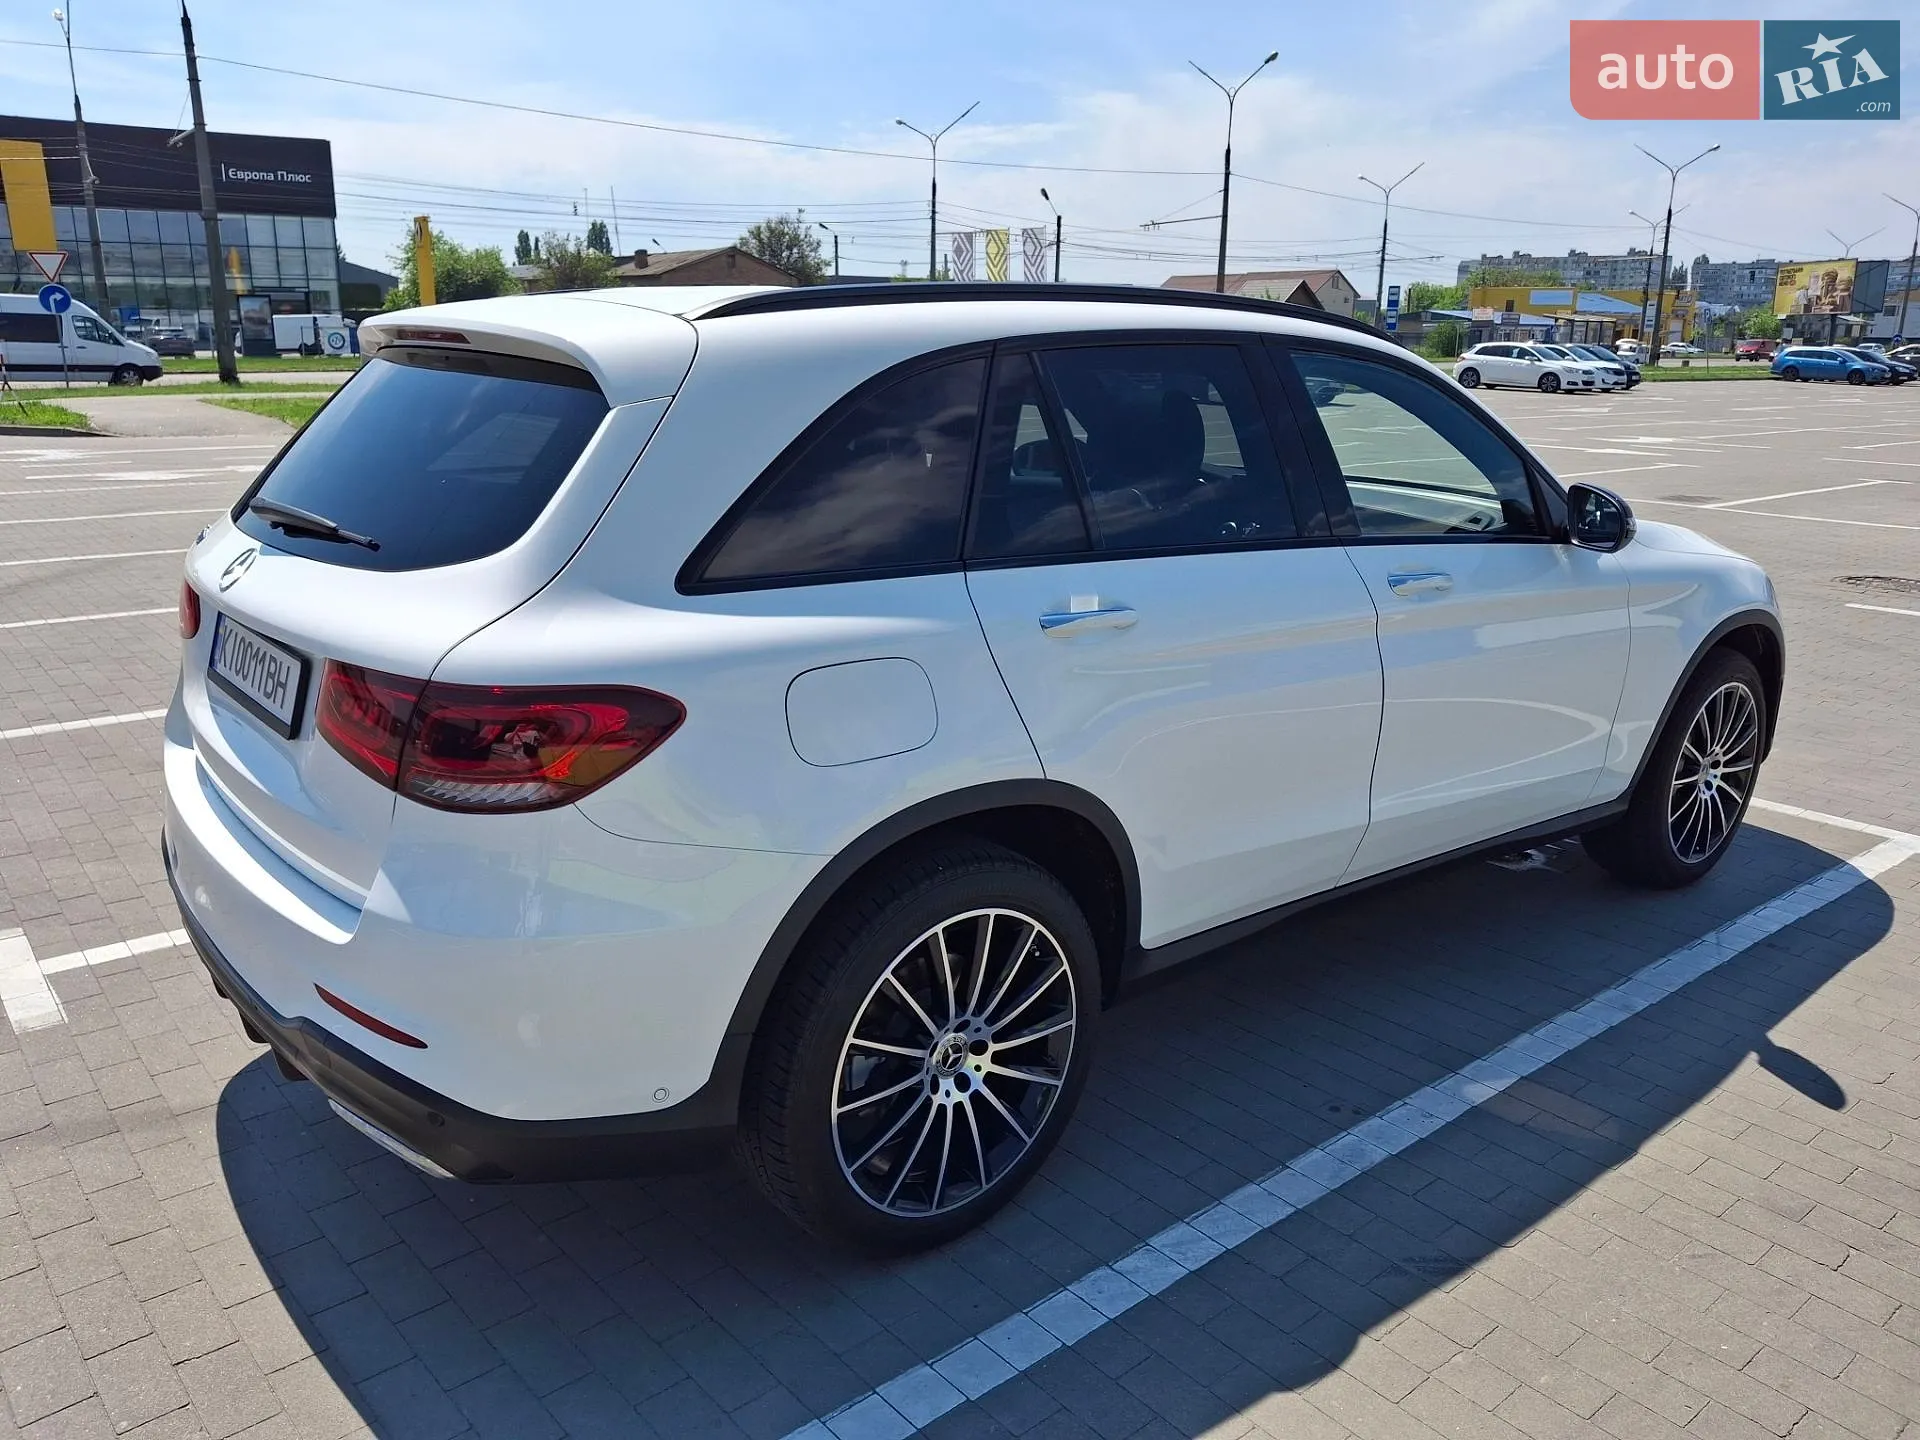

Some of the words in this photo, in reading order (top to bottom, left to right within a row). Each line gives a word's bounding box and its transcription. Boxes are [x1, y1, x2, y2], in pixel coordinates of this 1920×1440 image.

[228, 168, 275, 183] Європа
[277, 170, 312, 183] Плюс
[219, 625, 290, 710] KI0011BH
